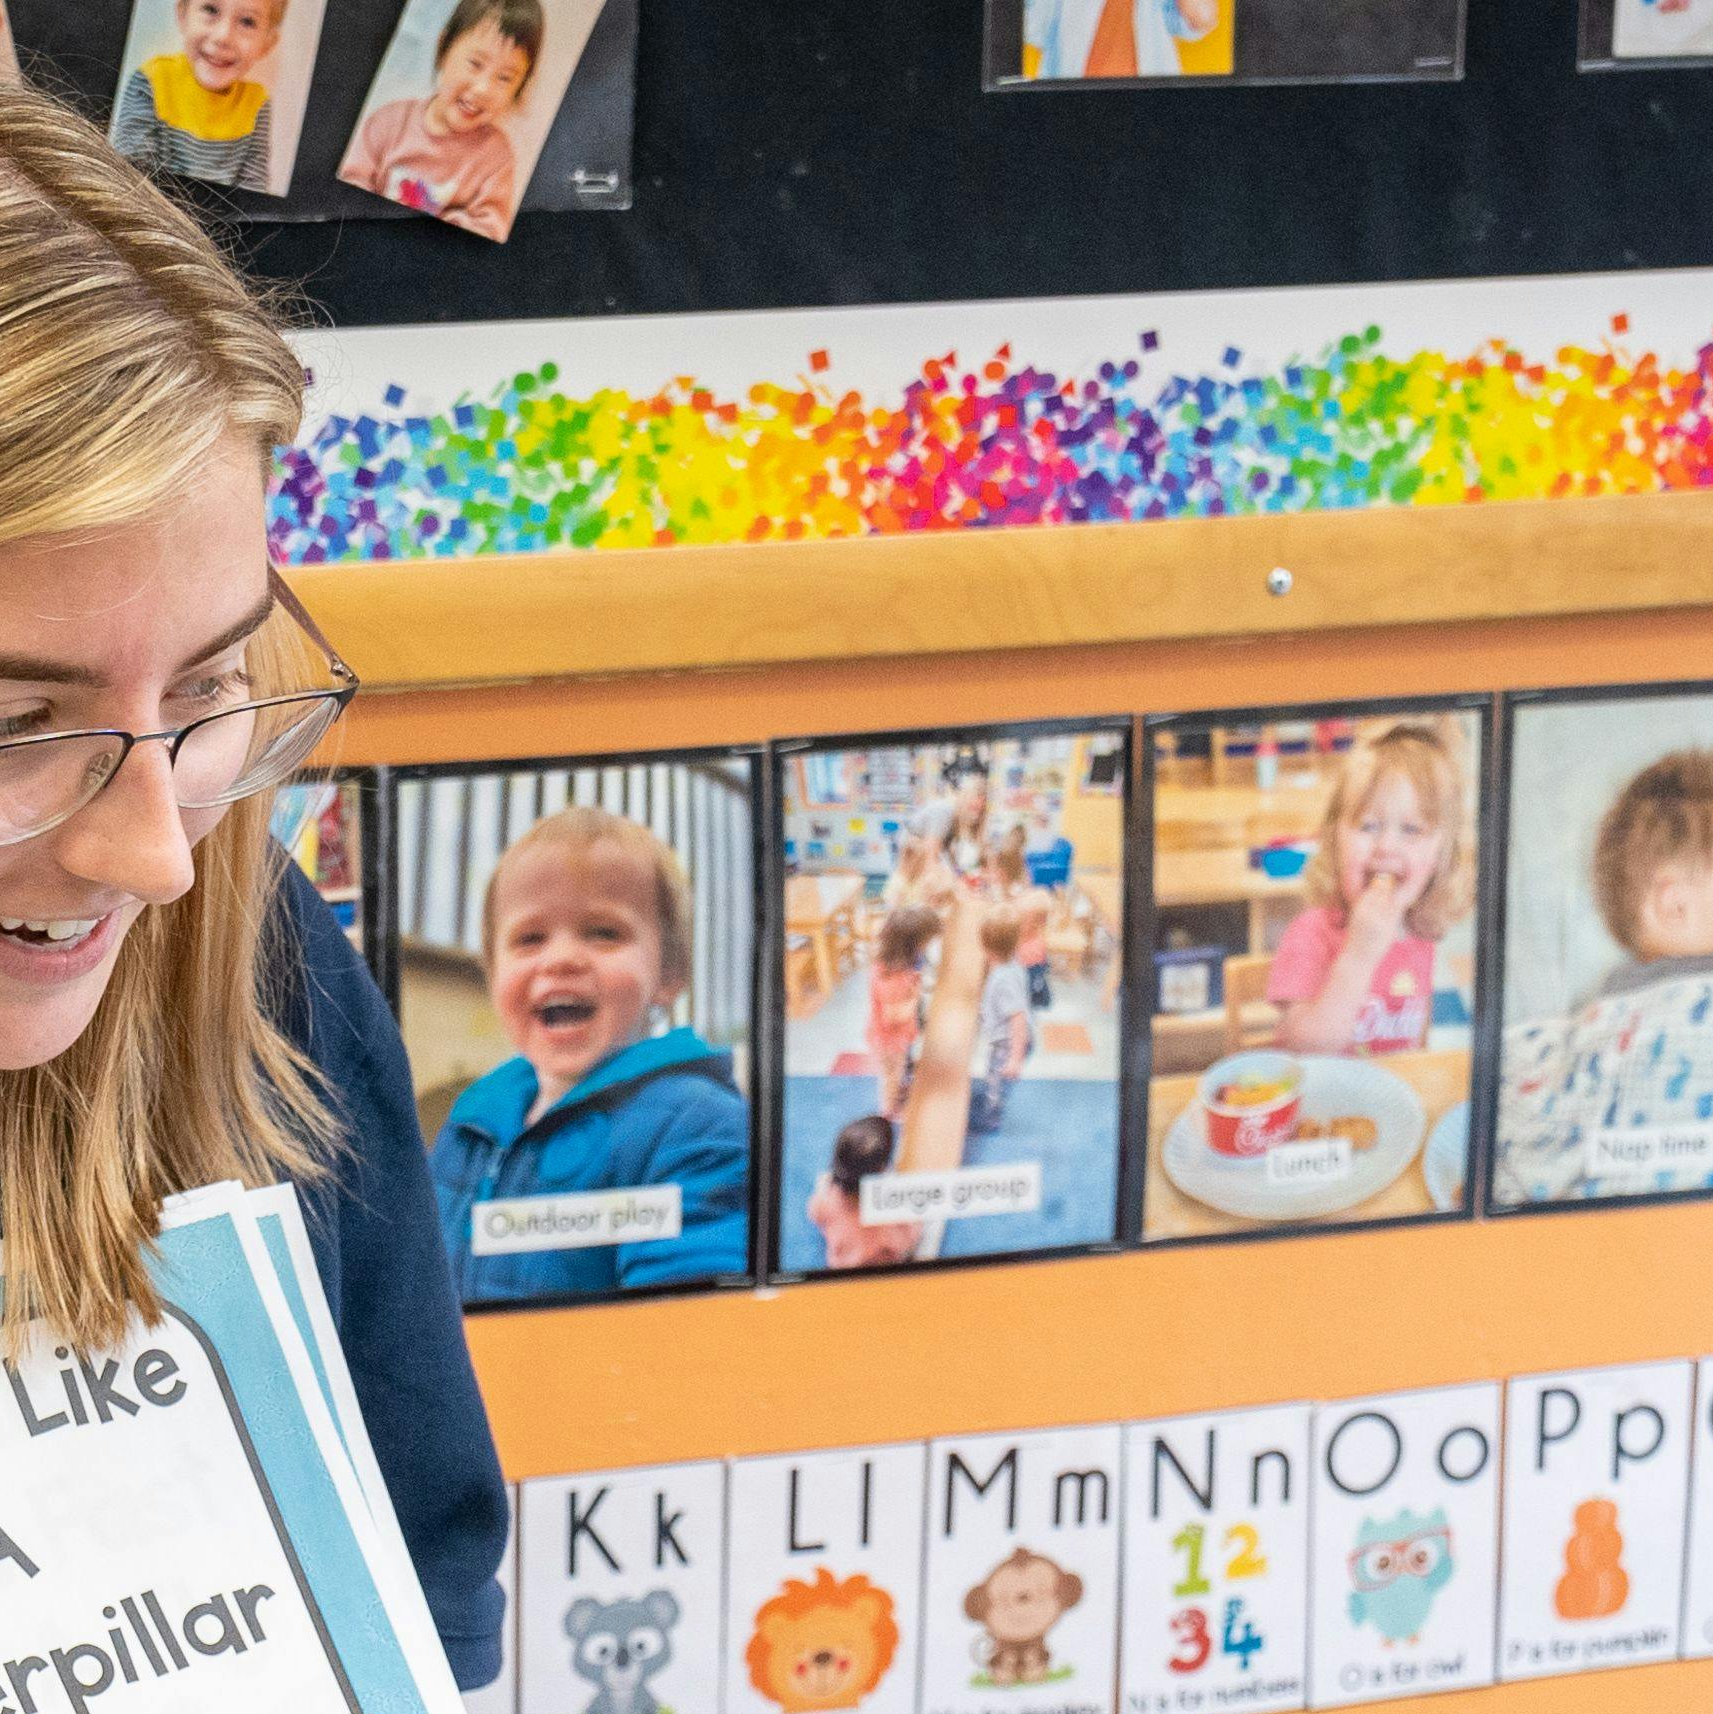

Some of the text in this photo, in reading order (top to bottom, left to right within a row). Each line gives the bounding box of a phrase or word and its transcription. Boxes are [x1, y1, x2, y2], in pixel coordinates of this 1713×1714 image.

[872, 1177, 1029, 1214] Large group
[485, 1198, 670, 1239] Outdoor play
[1, 1340, 189, 1438] Like
